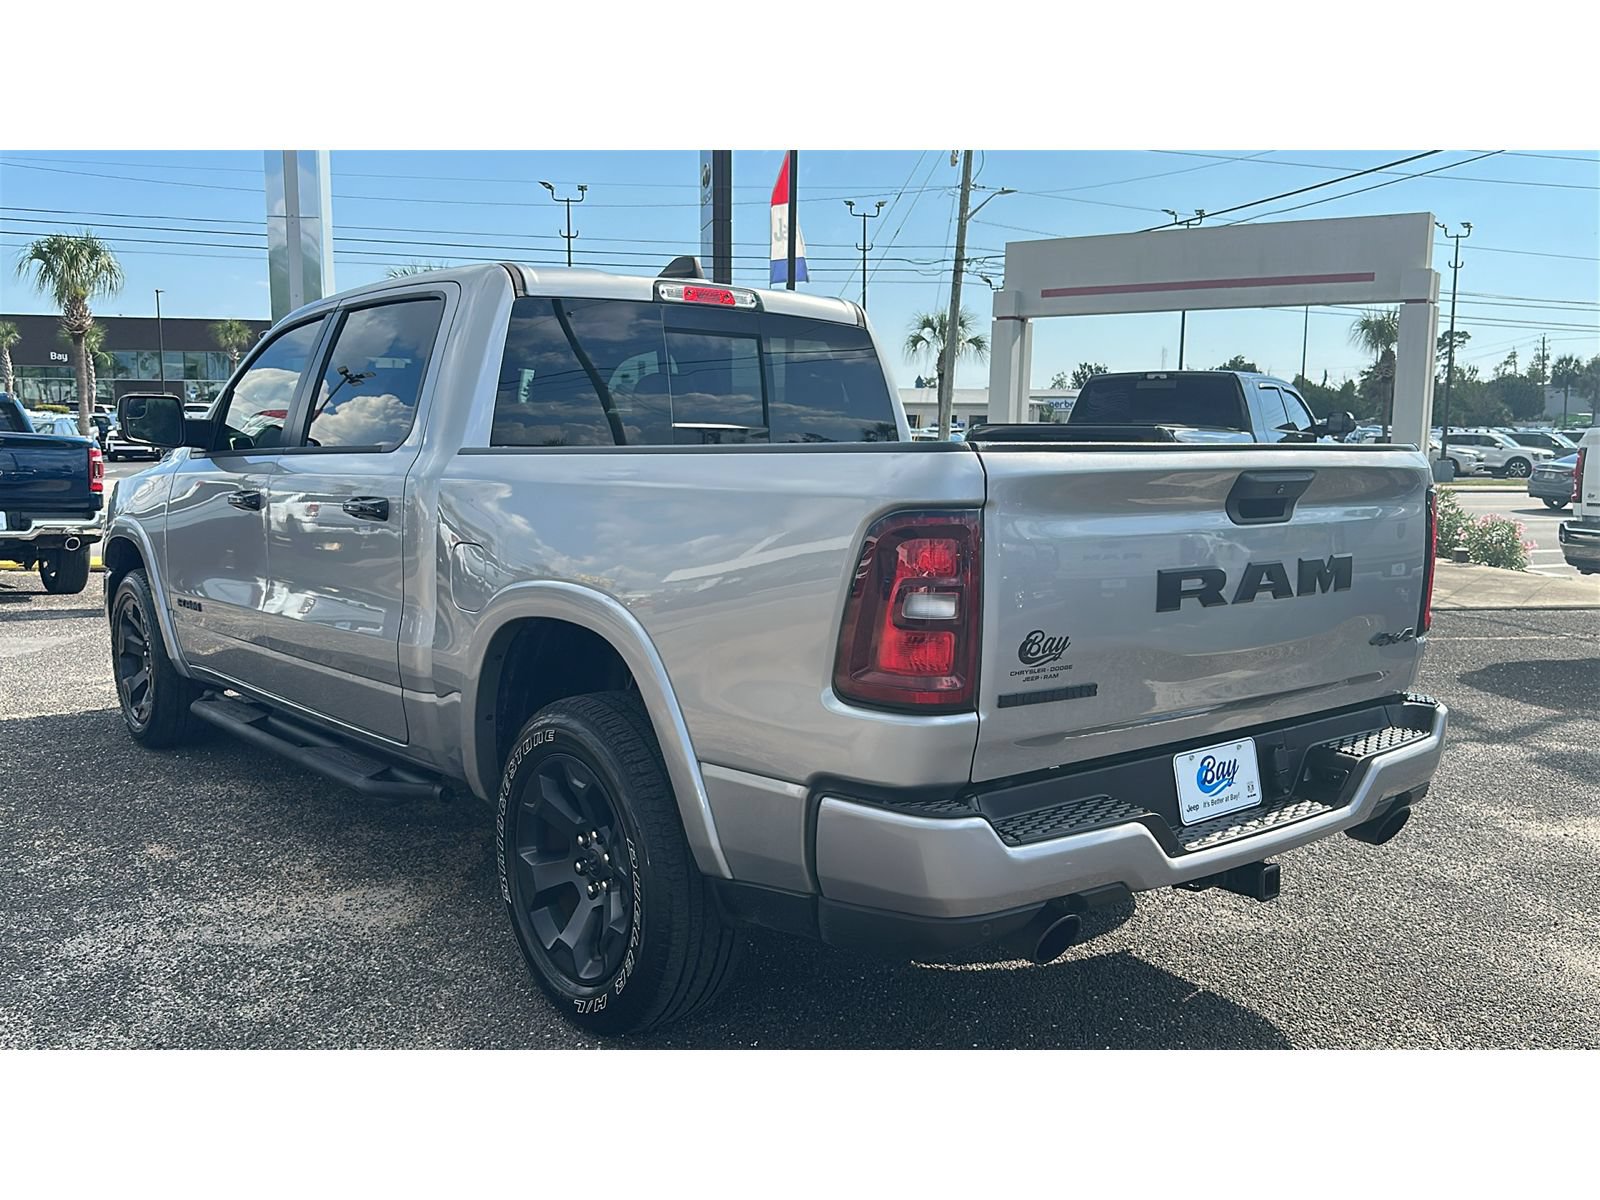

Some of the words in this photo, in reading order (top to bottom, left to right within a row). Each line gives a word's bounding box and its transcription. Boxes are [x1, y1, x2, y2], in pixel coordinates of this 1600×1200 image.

[50, 351, 68, 363] Bay
[1156, 553, 1352, 613] RAM
[1018, 630, 1071, 668] Bay
[1043, 673, 1059, 681] RAM
[1050, 664, 1073, 672] DODGE
[1197, 755, 1239, 794] Bay
[496, 729, 555, 904] BRIDGESTONE
[1186, 803, 1200, 813] Jeep
